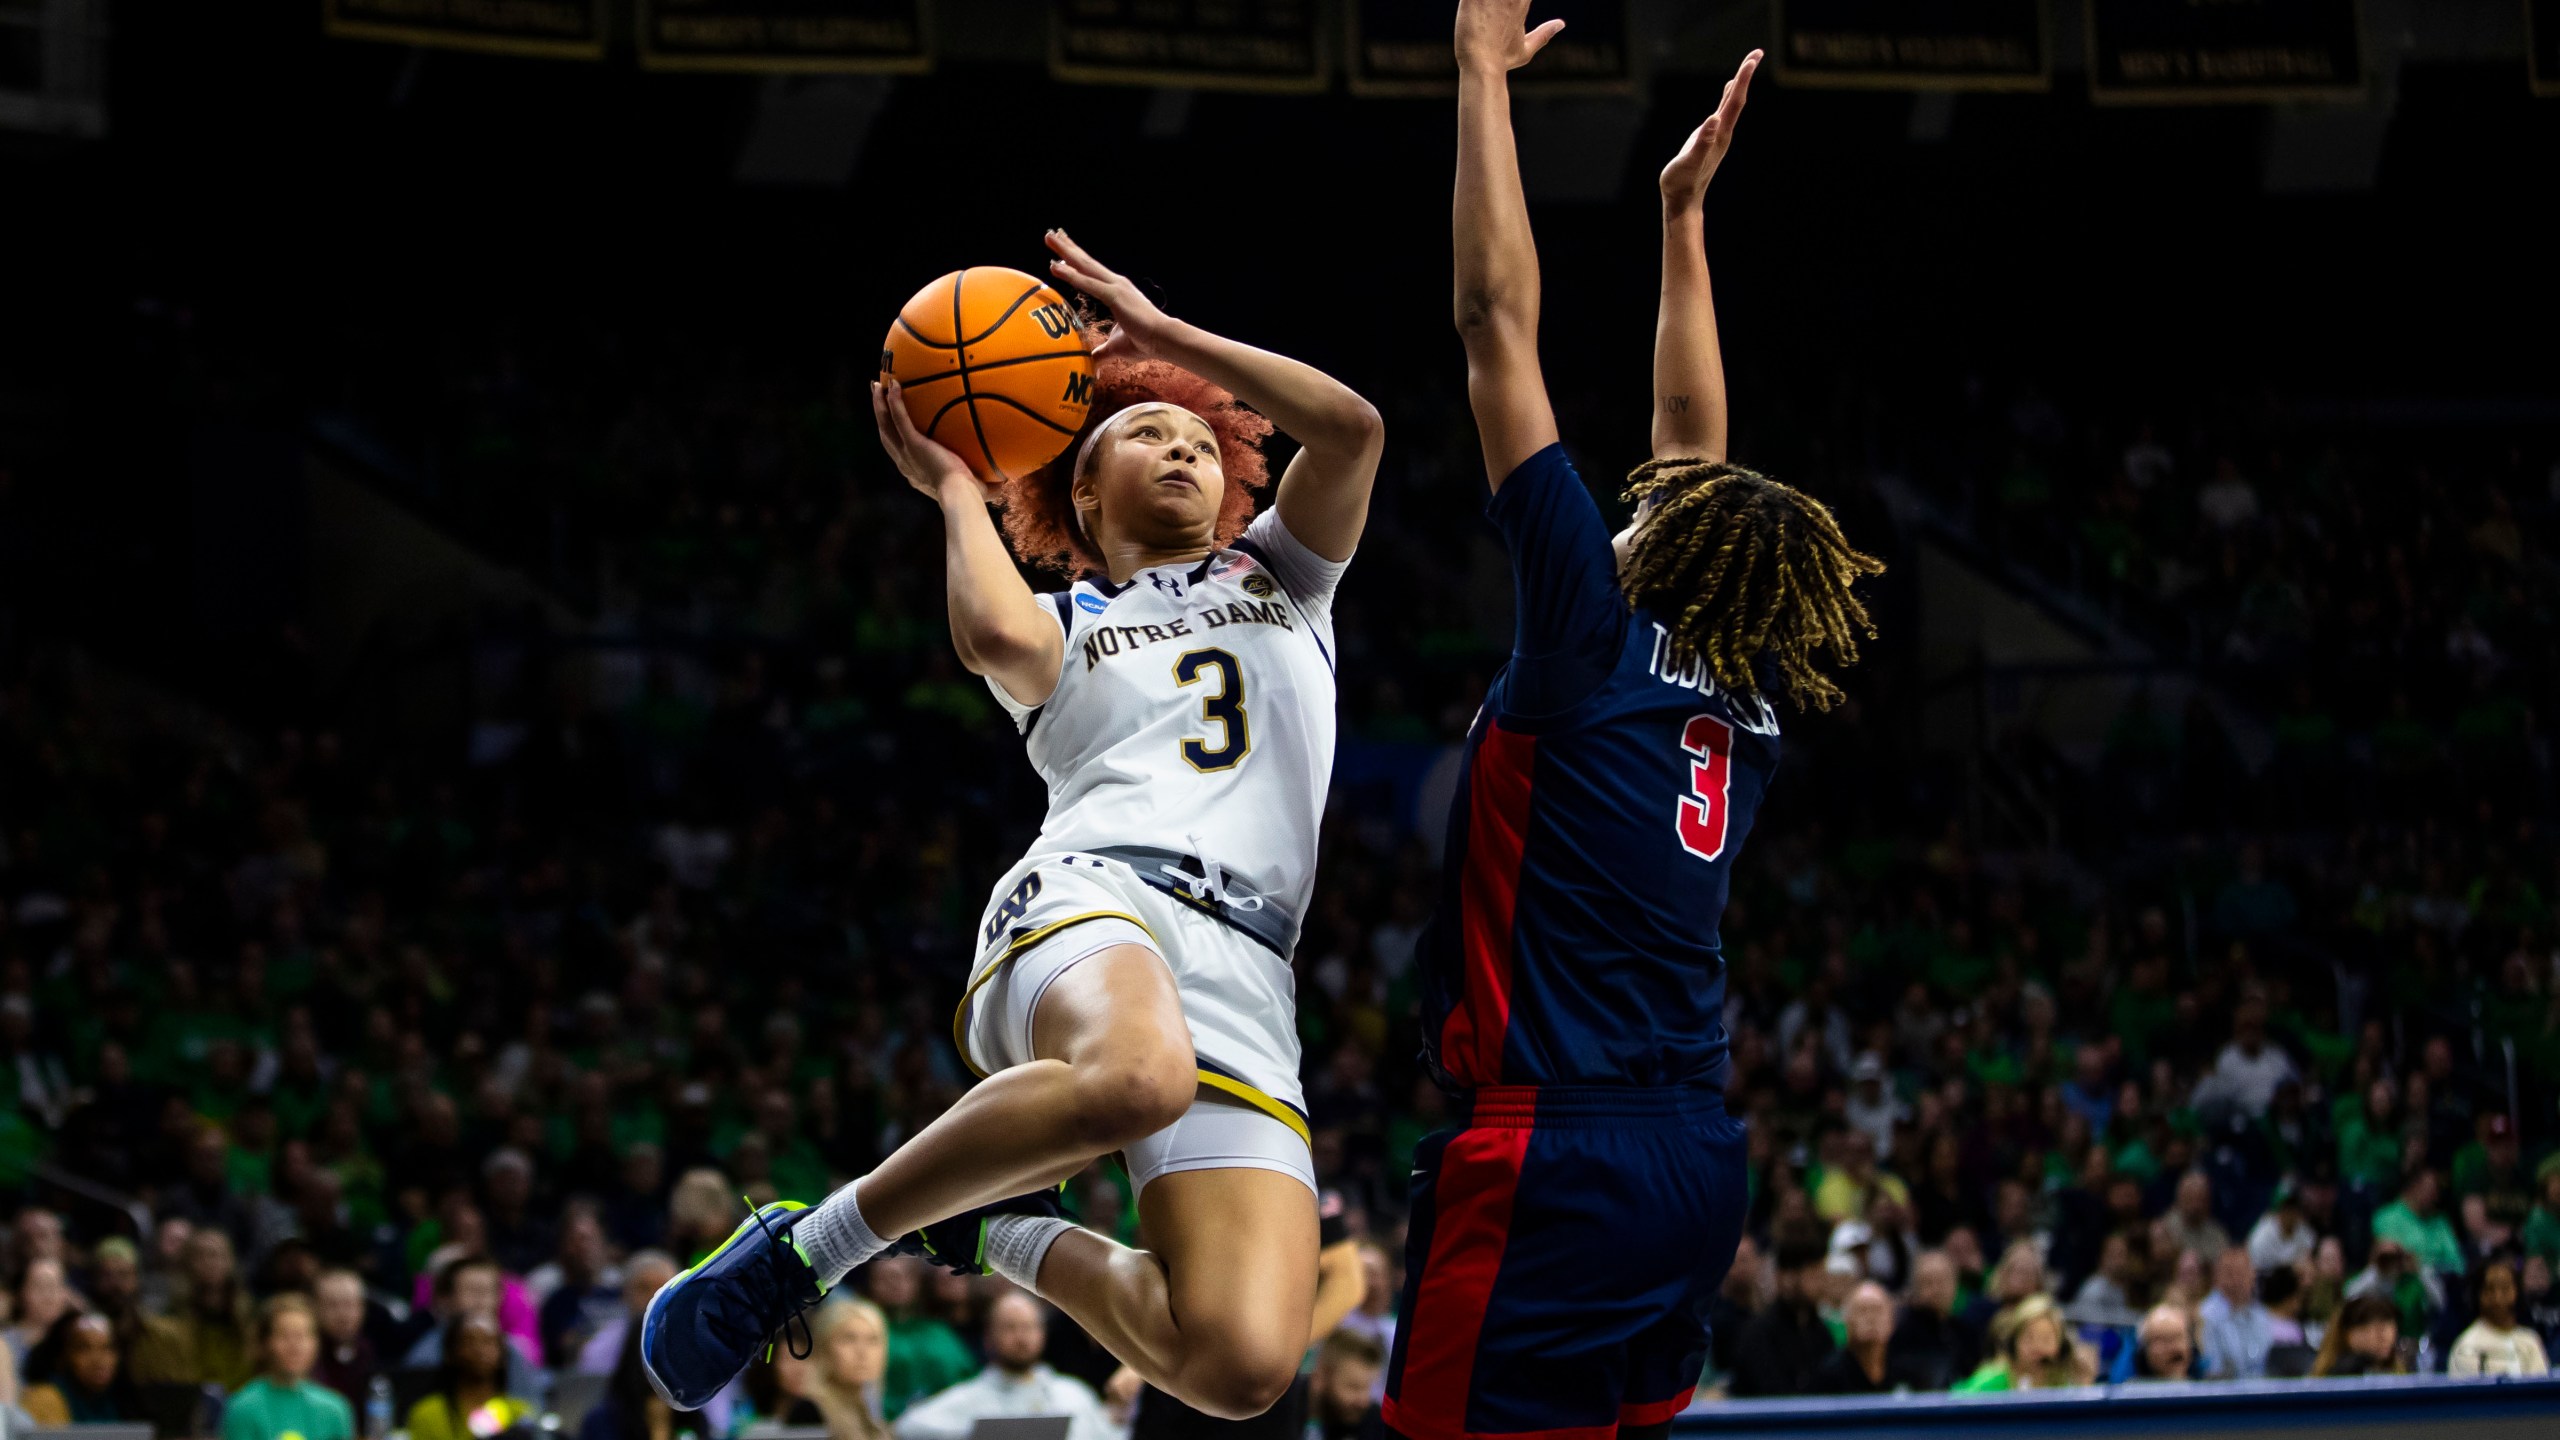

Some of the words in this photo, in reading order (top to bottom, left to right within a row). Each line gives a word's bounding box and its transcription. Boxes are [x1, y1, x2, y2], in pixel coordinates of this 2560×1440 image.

[1082, 618, 1193, 674] NOTRE
[1198, 599, 1295, 634] DAME
[1171, 646, 1252, 774] 3
[1675, 713, 1734, 863] 3
